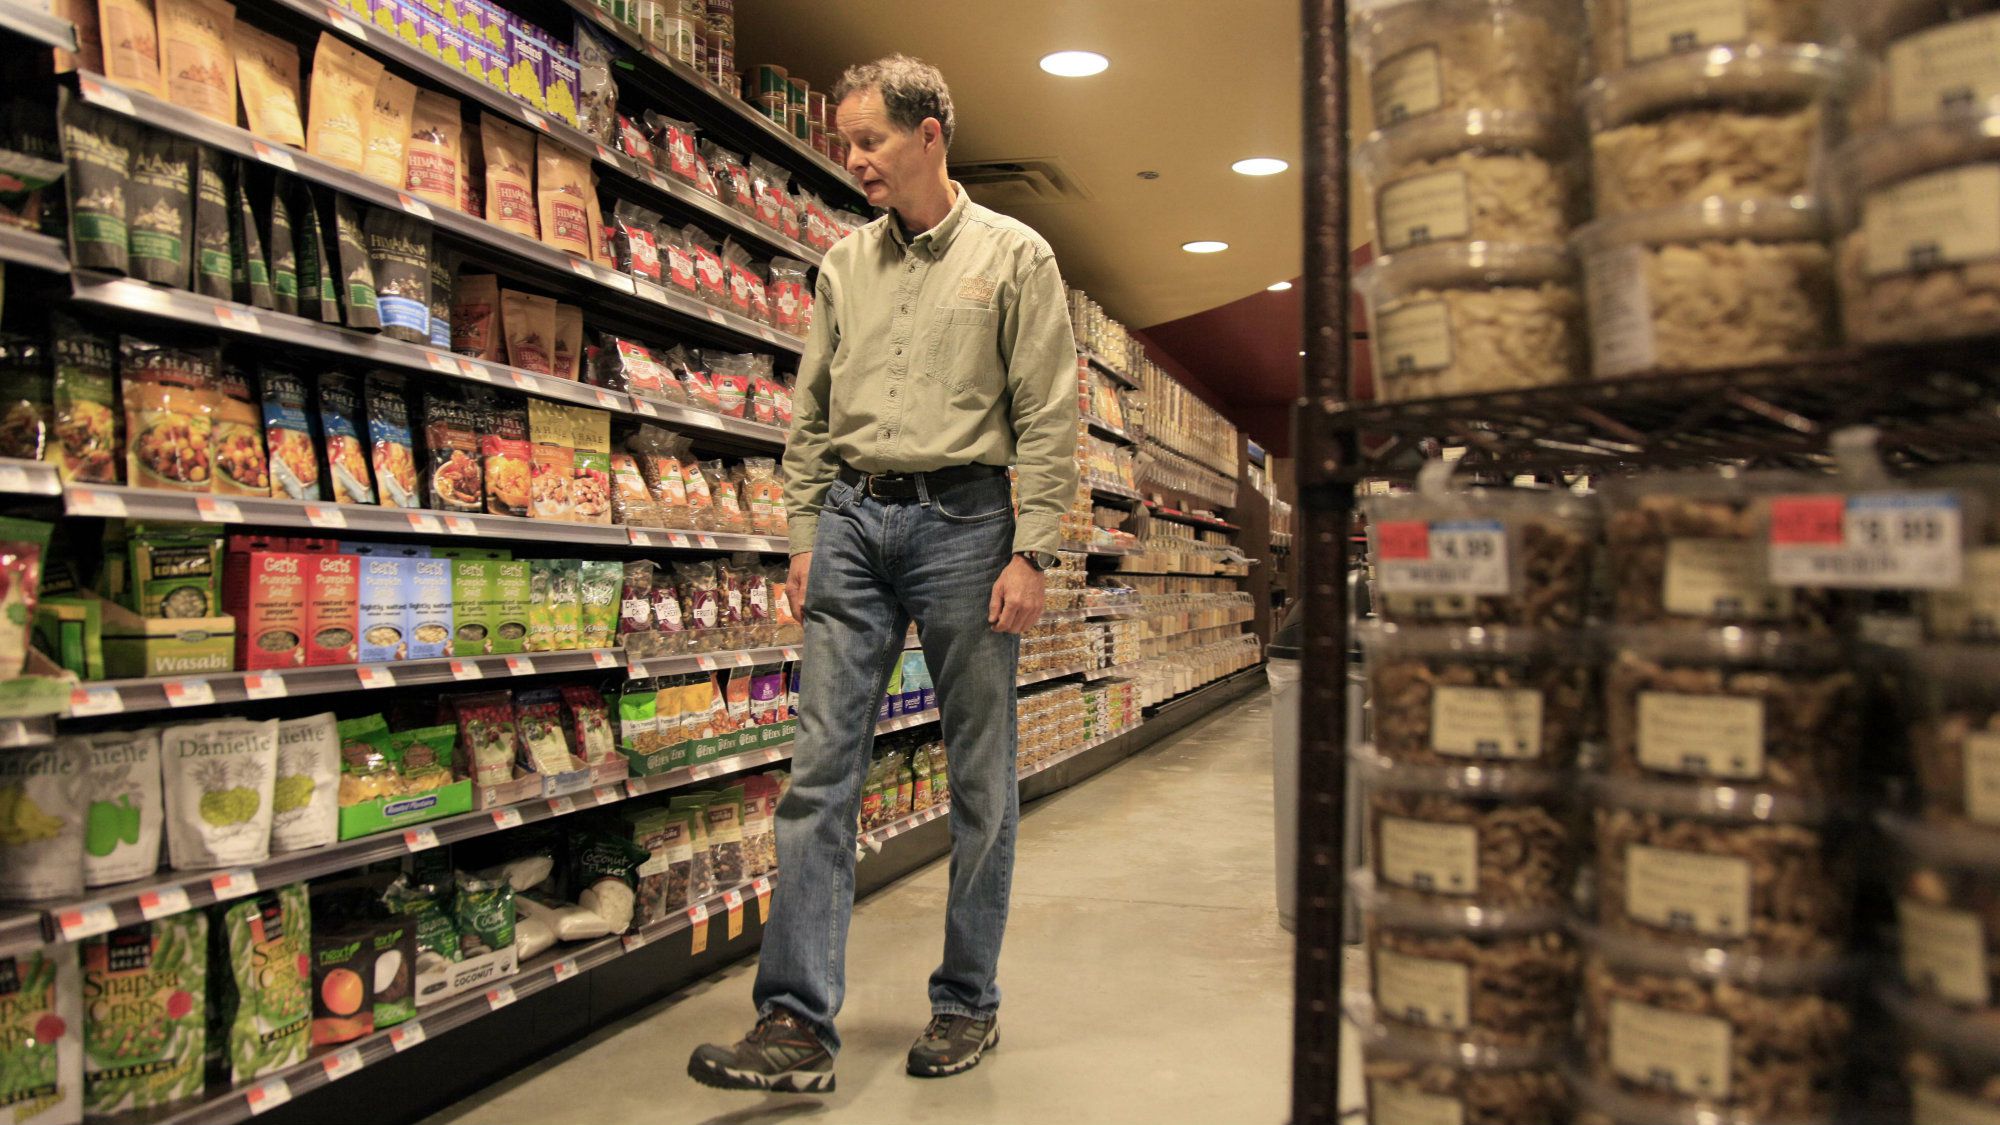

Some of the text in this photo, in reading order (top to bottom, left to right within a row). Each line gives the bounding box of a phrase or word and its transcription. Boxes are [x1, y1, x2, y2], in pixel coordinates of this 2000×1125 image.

[514, 39, 542, 60] raisins
[551, 59, 576, 80] raisins
[155, 654, 229, 672] Wasabi
[90, 744, 149, 768] nielle
[178, 735, 271, 758] Danielle
[581, 848, 631, 866] Coconut
[84, 971, 179, 998] Snapea
[454, 967, 493, 988] COCONUT
[90, 998, 165, 1024] Crisps
